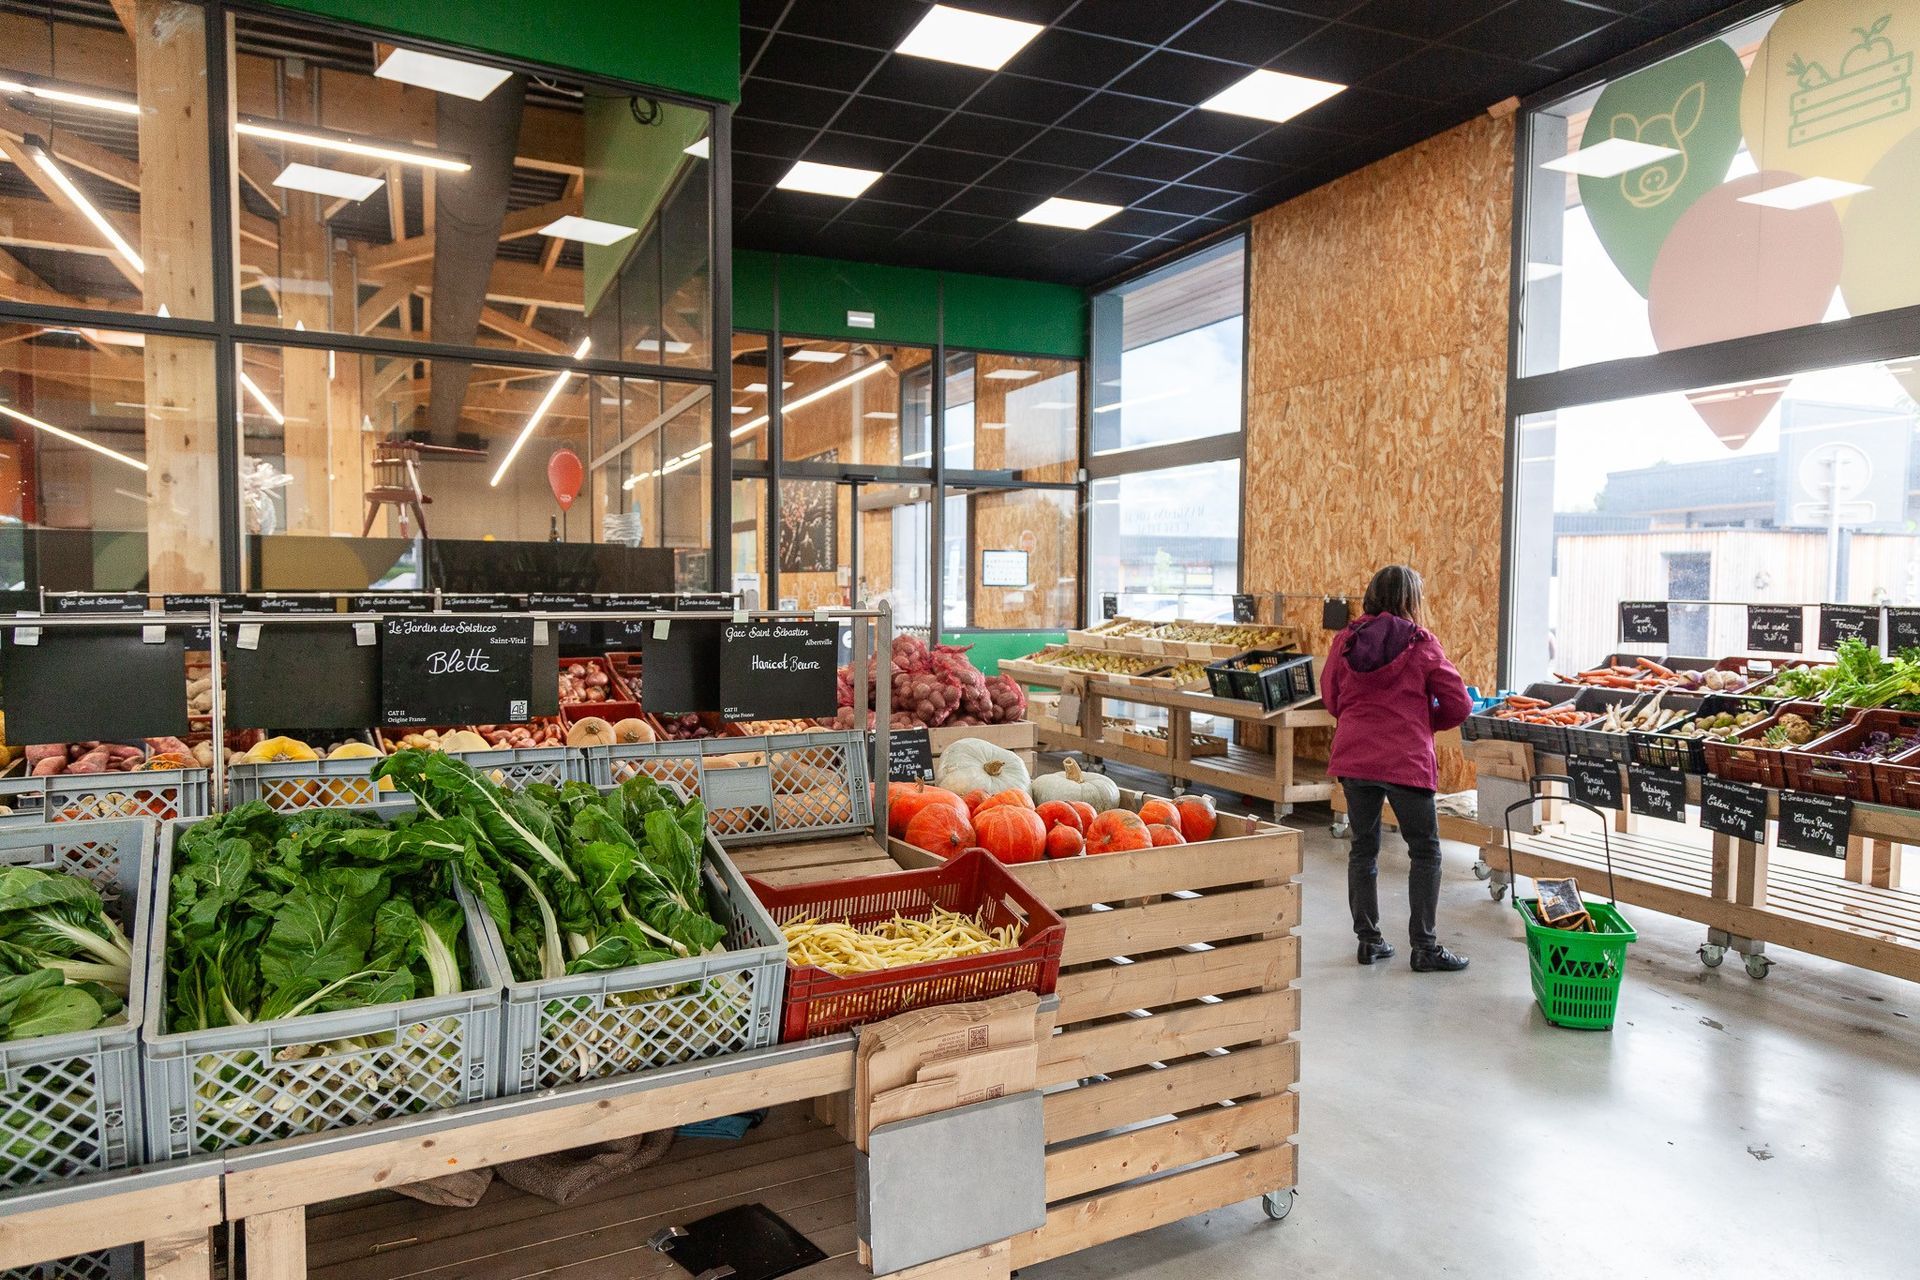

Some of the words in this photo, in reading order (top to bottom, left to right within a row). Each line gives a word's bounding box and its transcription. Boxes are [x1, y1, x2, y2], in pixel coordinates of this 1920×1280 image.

[388, 621, 402, 634] Le
[404, 621, 438, 634] Jardin
[440, 623, 456, 633] des
[455, 621, 497, 634] Solstices
[726, 627, 746, 642] Gaec
[748, 626, 770, 638] Saint
[773, 626, 809, 638] Sébastien
[426, 648, 500, 674] Blette
[752, 653, 788, 670] Haricot
[789, 656, 820, 672] Beurre
